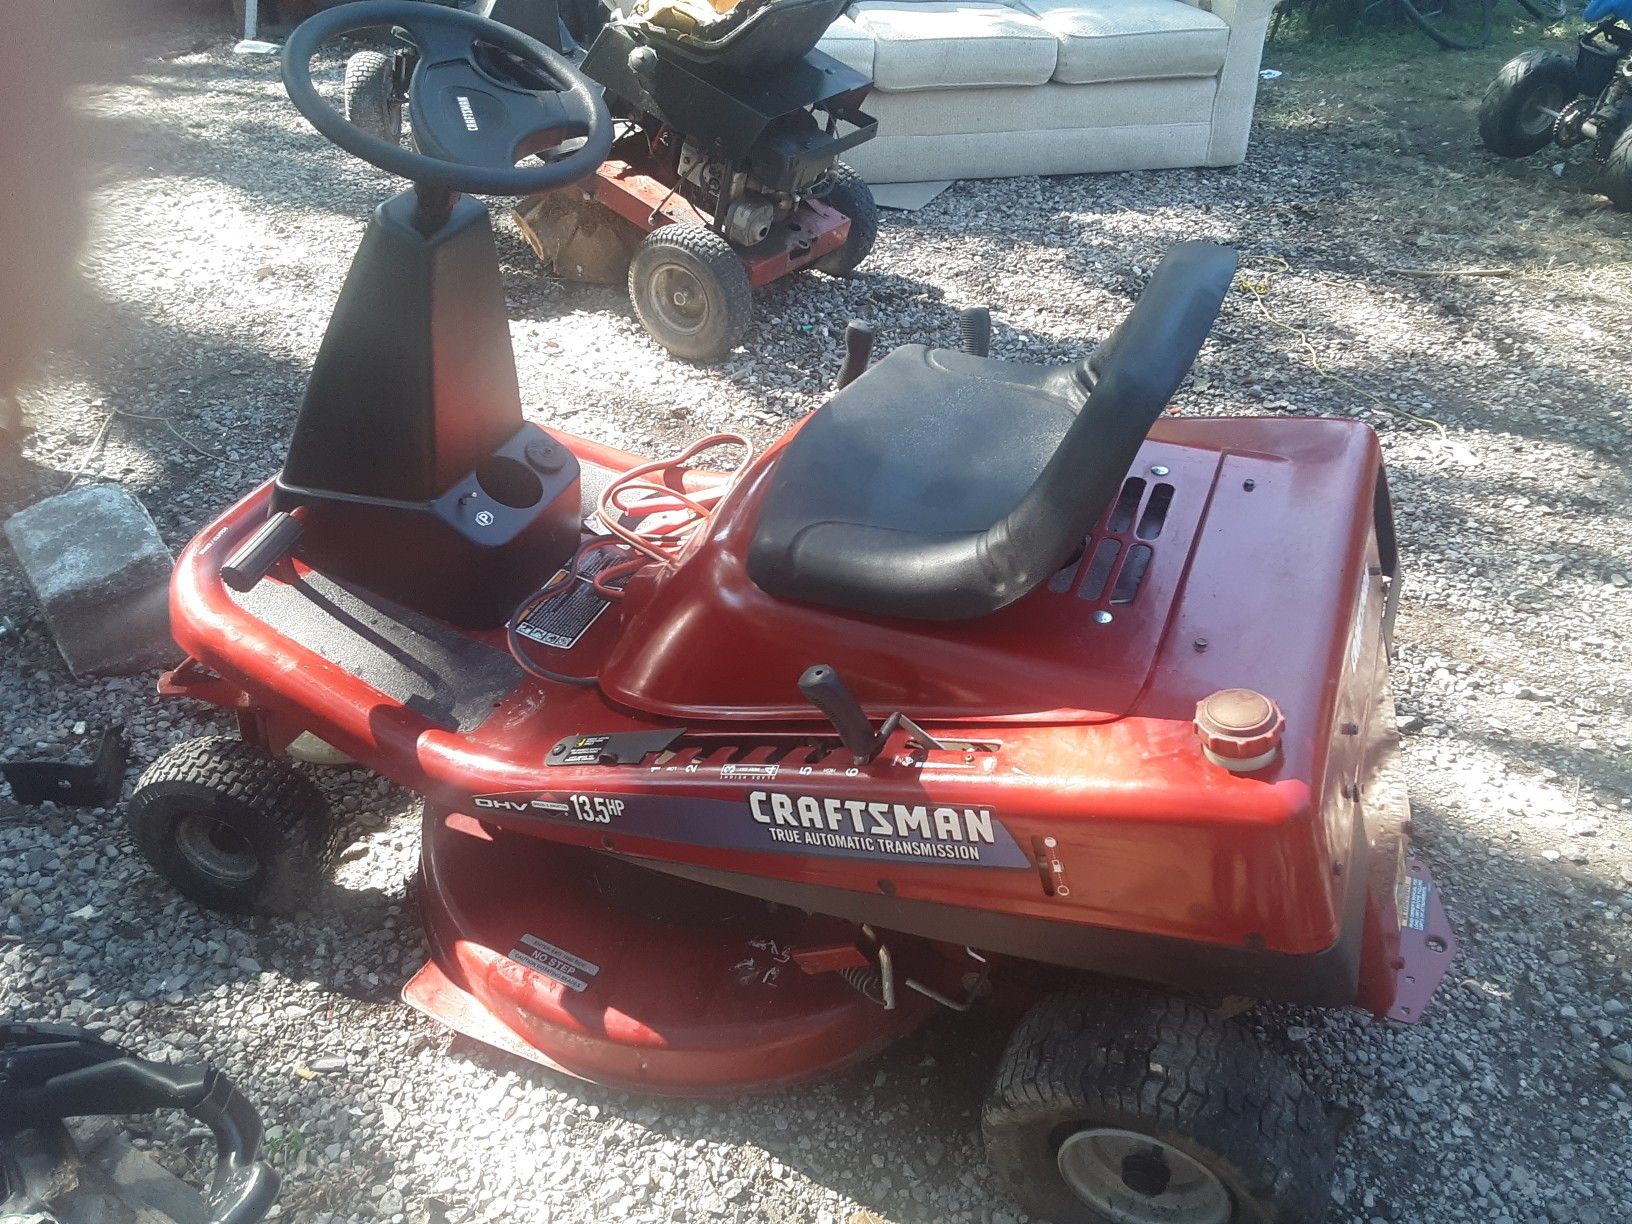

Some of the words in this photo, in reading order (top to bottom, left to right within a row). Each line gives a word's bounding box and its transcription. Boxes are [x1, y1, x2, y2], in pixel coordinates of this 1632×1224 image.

[799, 766, 812, 775] 5
[475, 798, 528, 811] OHV
[749, 791, 996, 844] CRAFTSMAN
[768, 828, 802, 844] TRUE
[805, 831, 875, 852] AUTOMATIC
[877, 839, 980, 861] TRANSMISSION
[531, 950, 546, 963] NO
[548, 958, 576, 975] STEP
